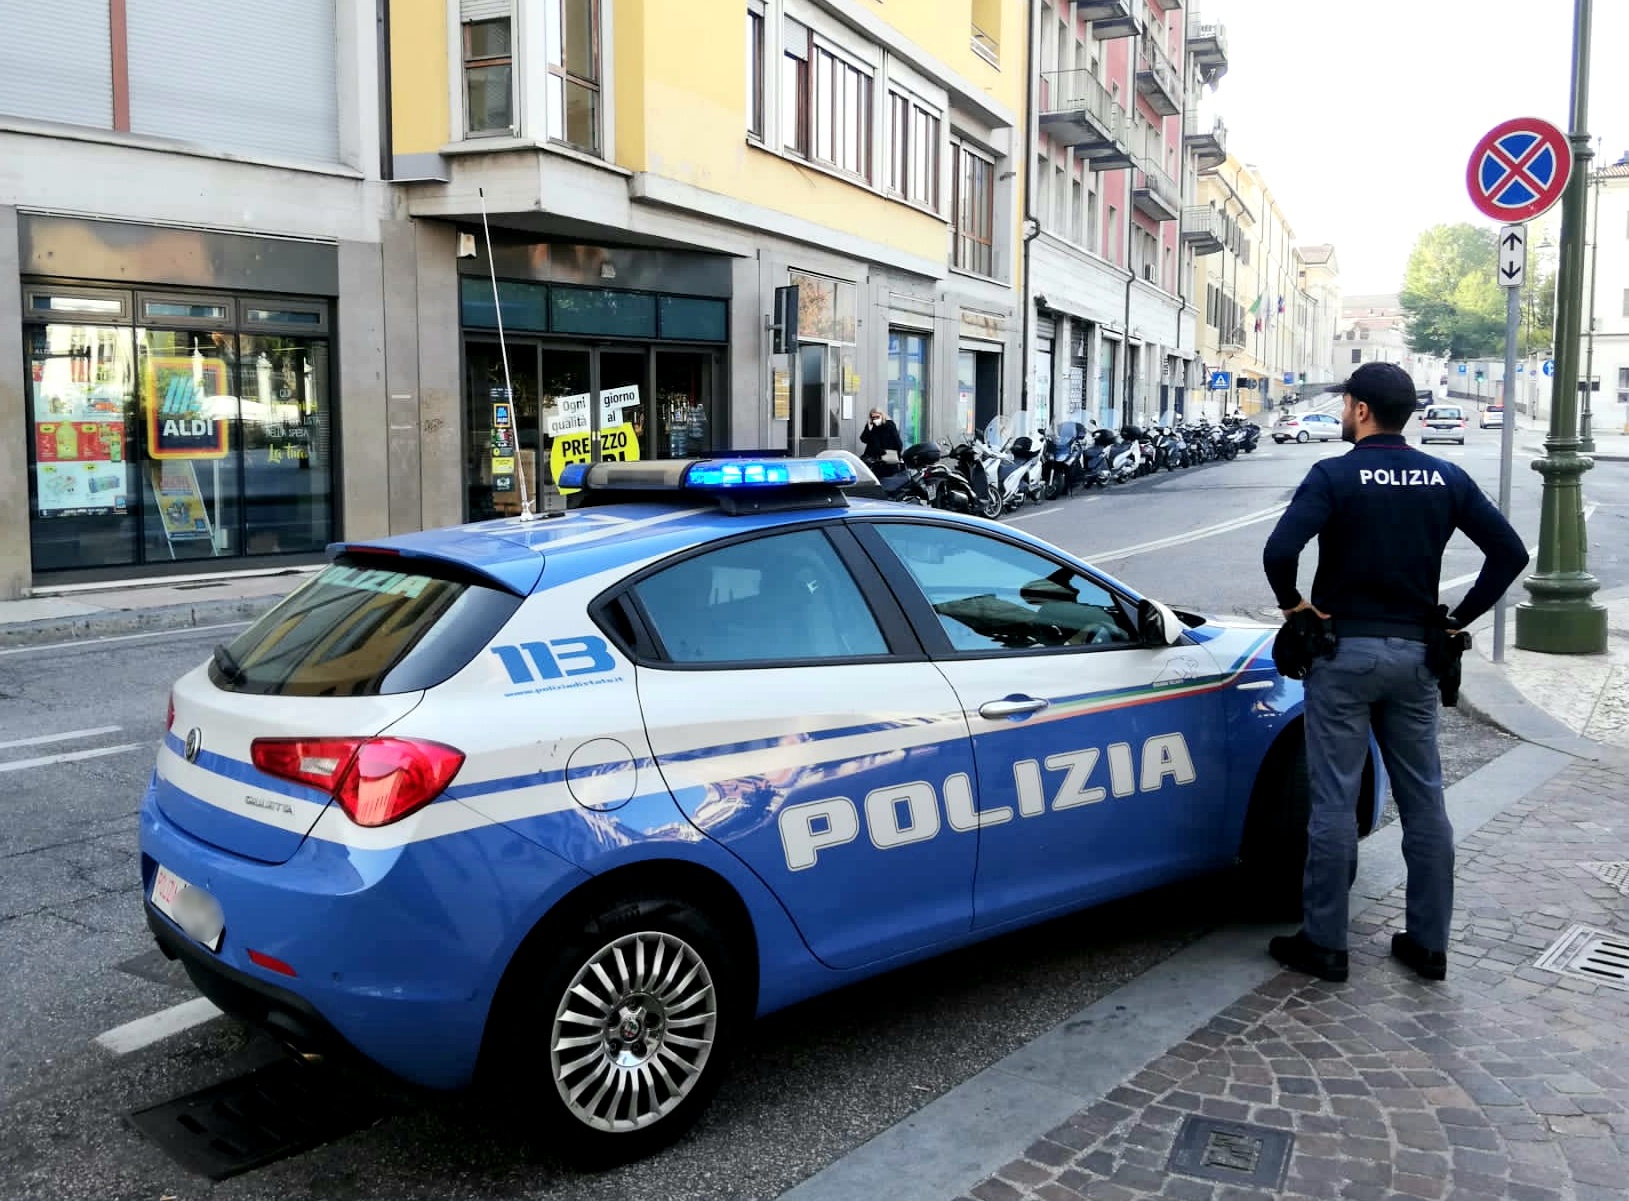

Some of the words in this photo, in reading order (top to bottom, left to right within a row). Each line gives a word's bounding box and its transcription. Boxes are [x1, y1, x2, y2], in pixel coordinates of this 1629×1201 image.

[562, 396, 586, 413] Ogni
[603, 390, 635, 408] giorno
[163, 419, 213, 436] ALDI
[551, 415, 587, 432] qualità
[607, 411, 616, 422] al
[561, 431, 627, 457] PREZZO
[1360, 469, 1446, 486] POLIZIA
[490, 635, 616, 684] 113
[778, 731, 1197, 872] POLIZIA
